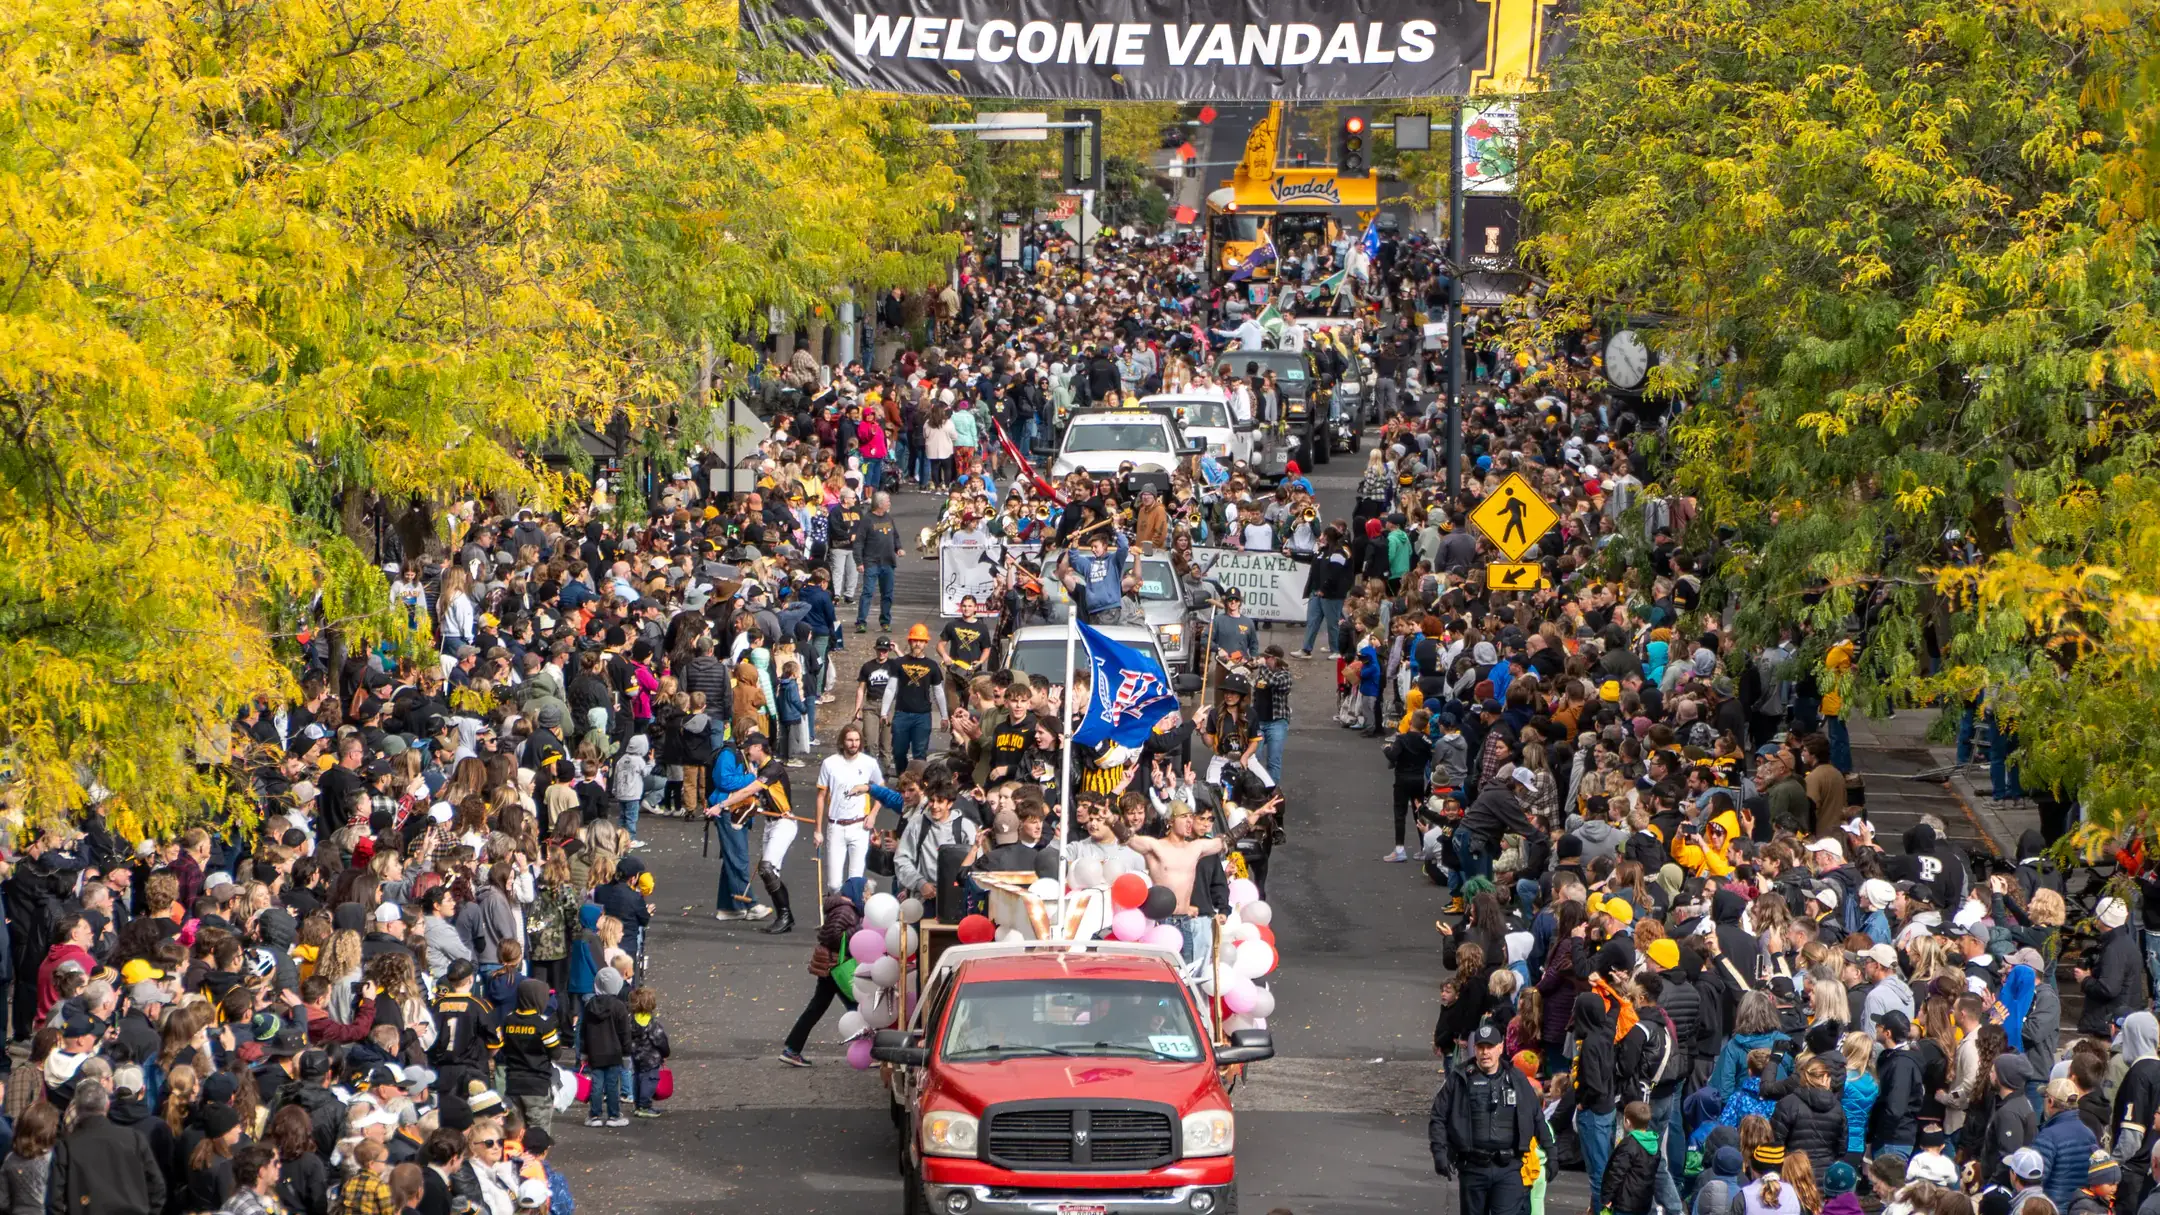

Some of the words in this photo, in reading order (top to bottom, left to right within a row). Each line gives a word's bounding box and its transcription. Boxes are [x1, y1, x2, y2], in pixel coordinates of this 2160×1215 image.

[853, 14, 1151, 66] WELCOME
[1163, 19, 1437, 66] VANDALS
[1270, 176, 1341, 204] Vandals
[1218, 572, 1280, 590] MIDDLE
[1242, 591, 1279, 607] HOOL
[1257, 608, 1281, 617] IDAHO
[996, 732, 1025, 749] IDAHO
[1917, 855, 1943, 882] P
[446, 1016, 459, 1052] 1
[506, 1025, 536, 1036] IDAHO
[1157, 1042, 1192, 1053] B13
